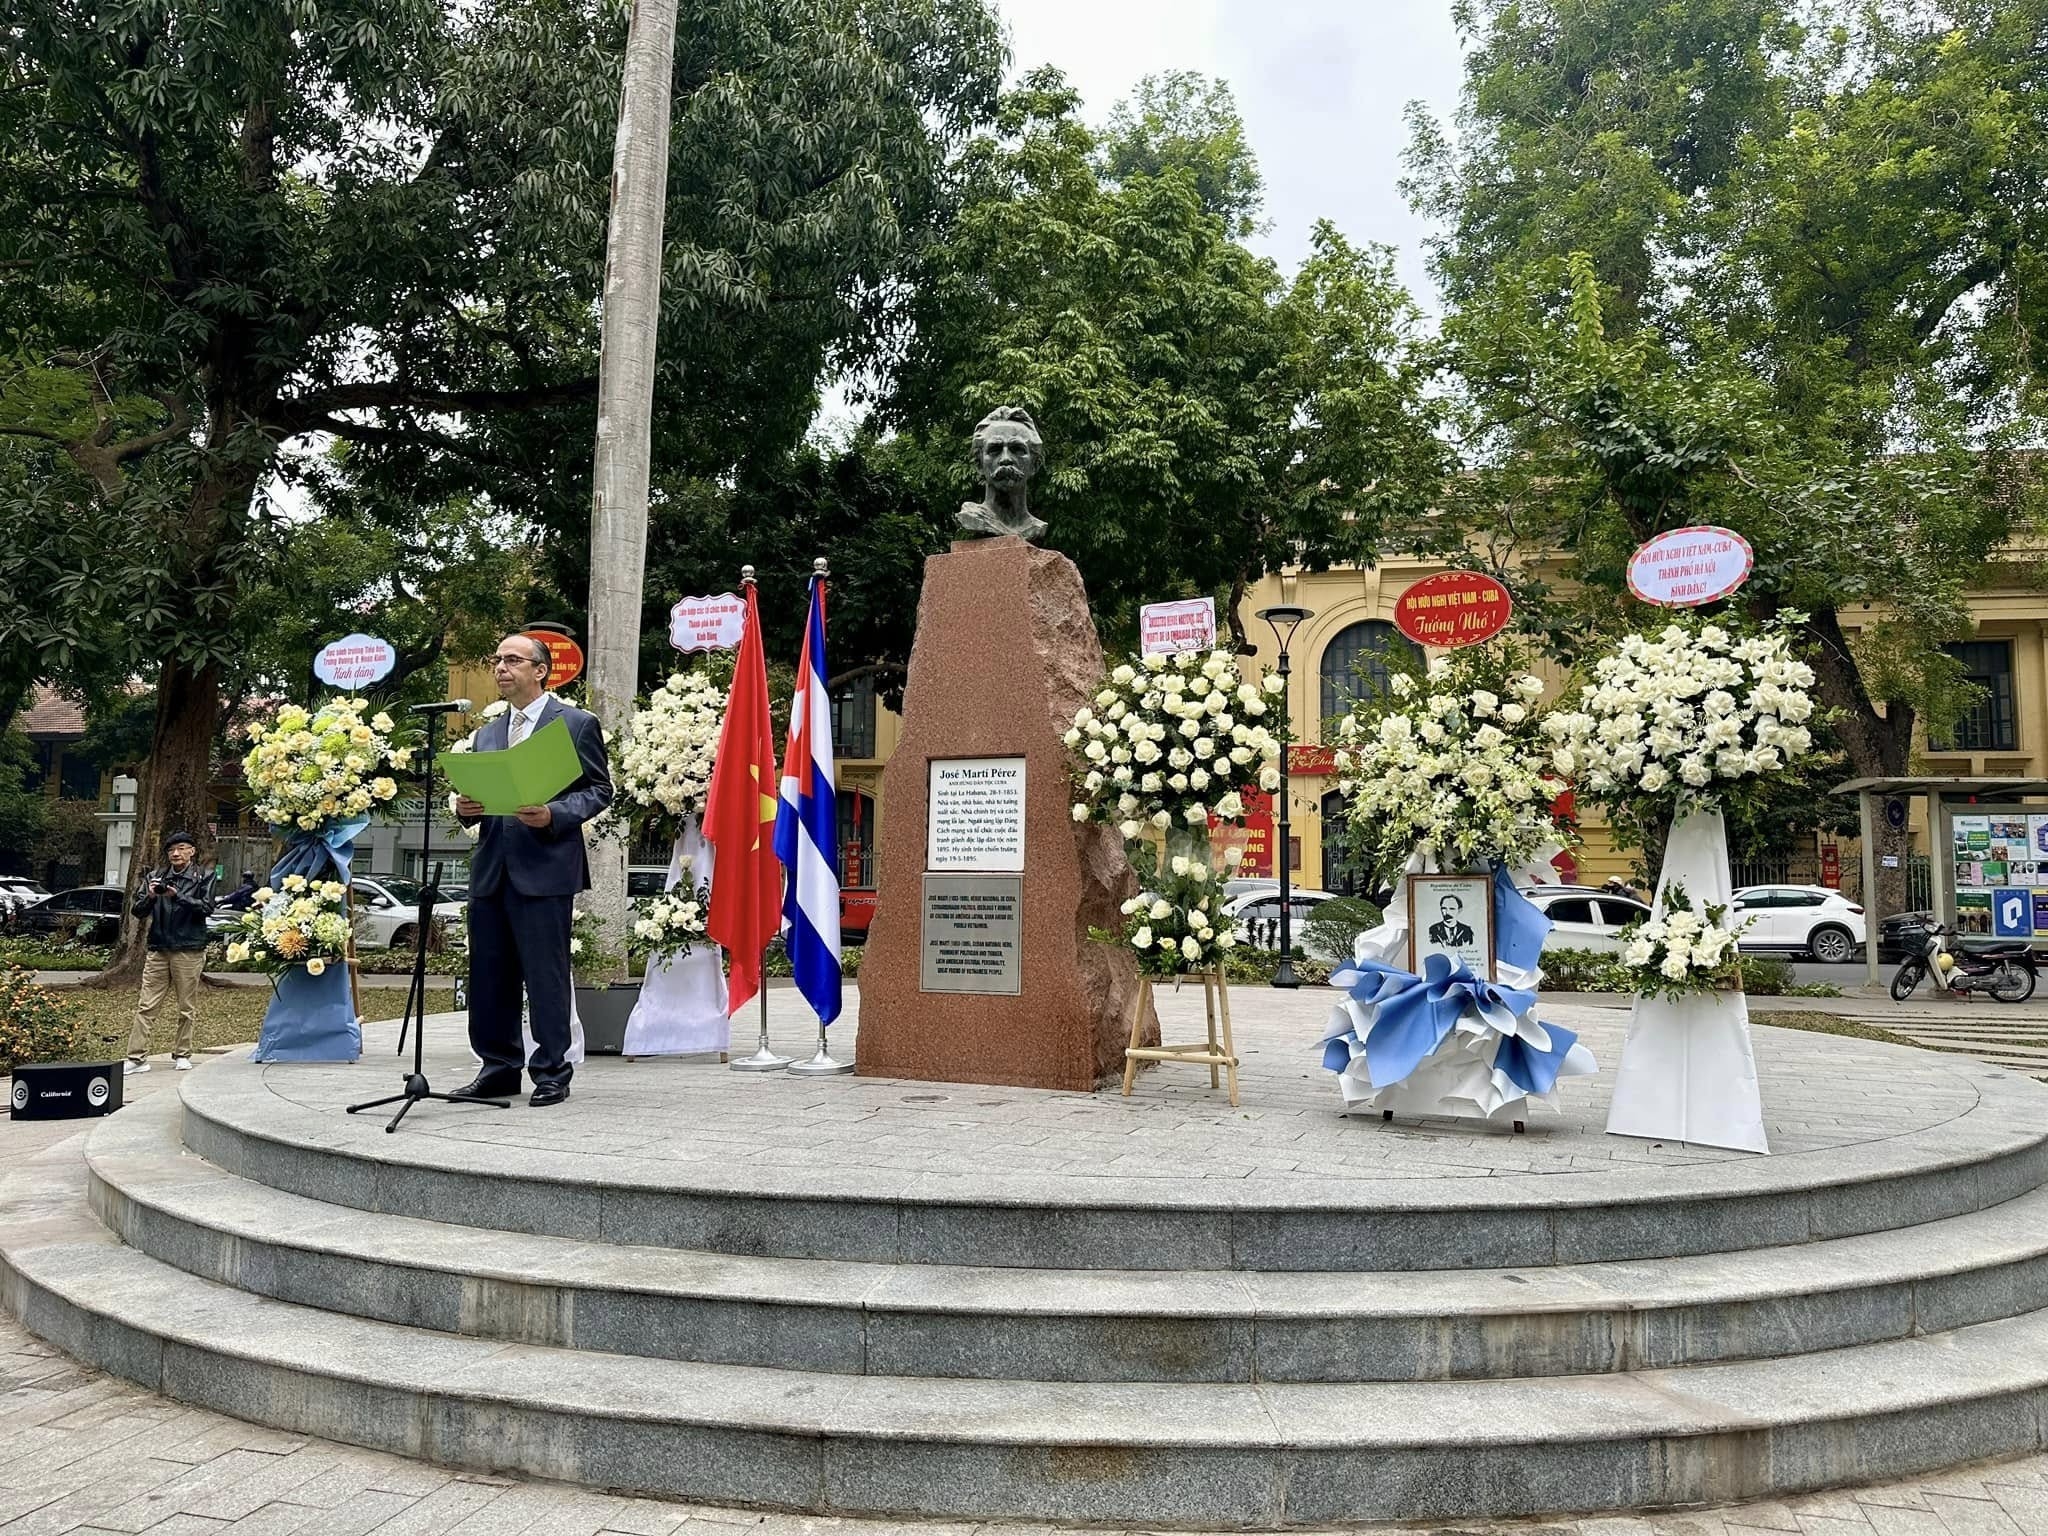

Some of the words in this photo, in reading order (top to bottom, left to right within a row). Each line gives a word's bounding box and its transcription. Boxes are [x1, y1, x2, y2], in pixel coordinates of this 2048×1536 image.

[1682, 545, 1696, 559] VIỆT
[1406, 596, 1417, 612] HỘI
[1418, 593, 1431, 609] HỮU
[1432, 594, 1447, 609] NGHỊ
[1448, 592, 1461, 607] VIỆT
[1462, 591, 1477, 604] NAM
[1482, 590, 1499, 602] CUBA
[940, 768, 960, 779] José
[962, 768, 988, 778] Martí
[991, 768, 1016, 778] Pérez
